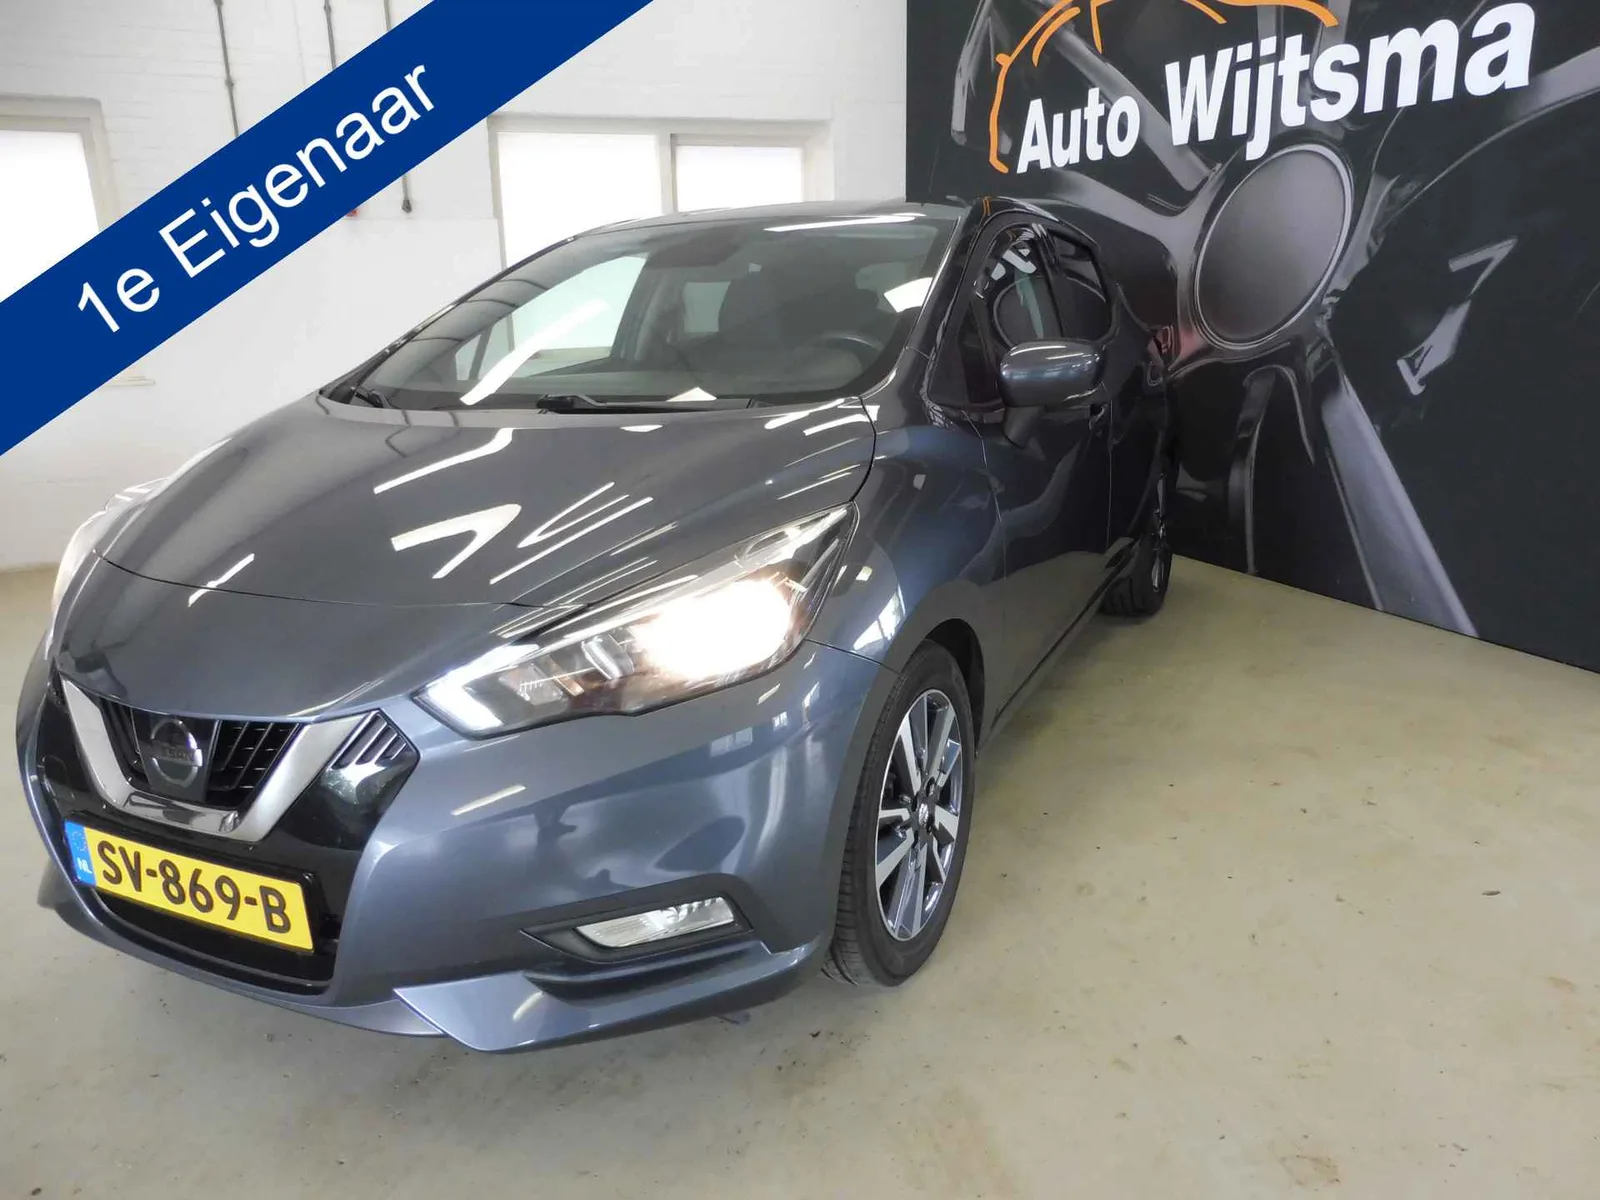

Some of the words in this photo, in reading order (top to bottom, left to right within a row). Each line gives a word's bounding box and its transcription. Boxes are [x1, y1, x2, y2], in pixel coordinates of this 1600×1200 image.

[1016, 87, 1141, 174] Auto
[1165, 2, 1535, 161] Wijtsma
[76, 856, 93, 874] NL
[97, 840, 291, 934] SV-869-B
